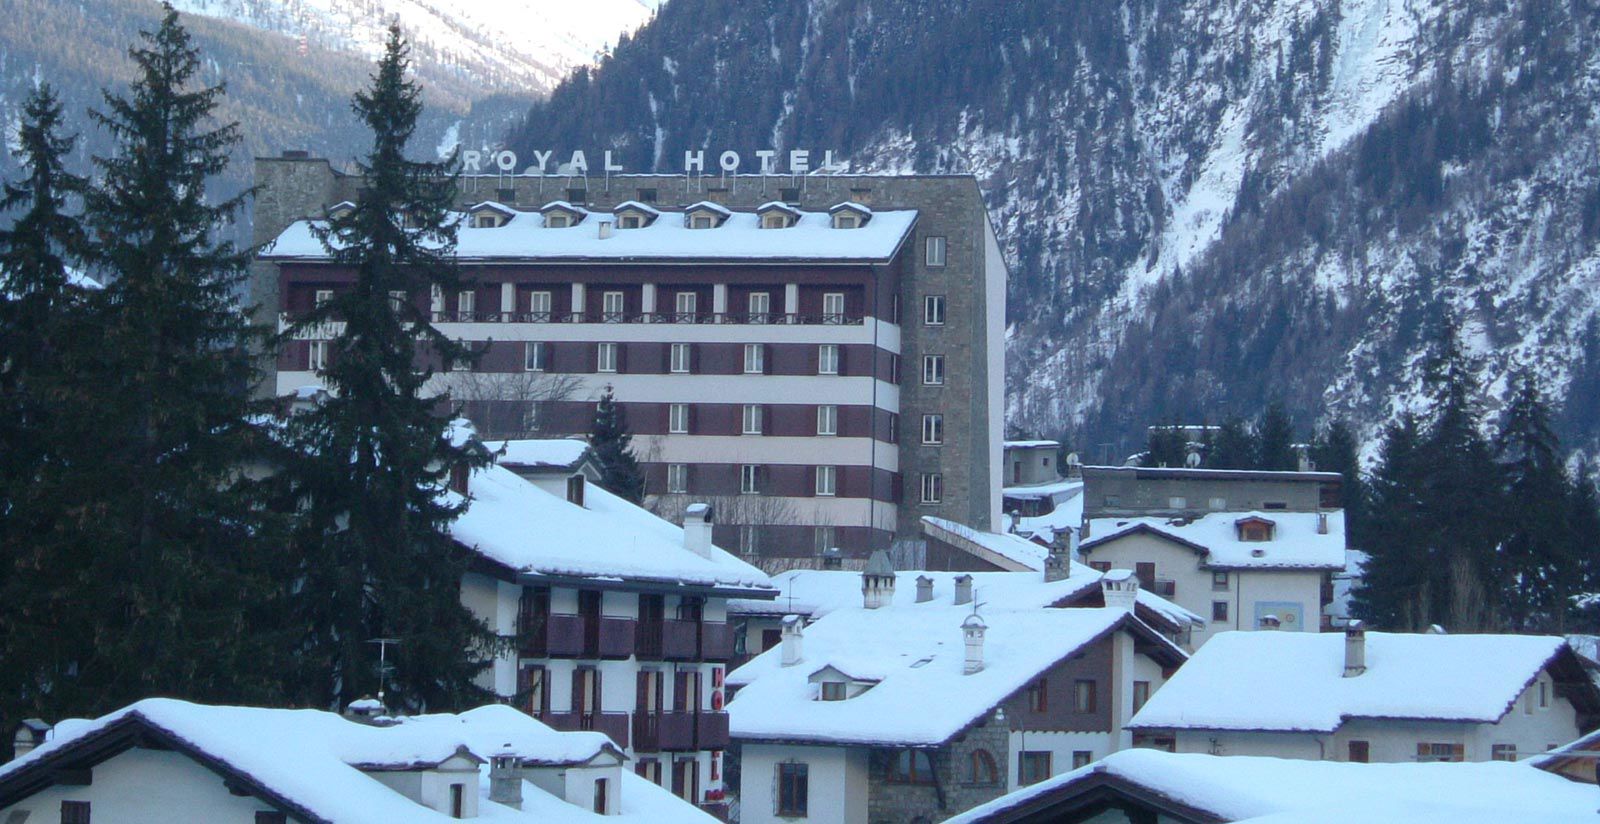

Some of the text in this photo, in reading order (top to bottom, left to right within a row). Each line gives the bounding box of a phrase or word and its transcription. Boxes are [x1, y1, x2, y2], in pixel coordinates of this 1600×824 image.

[462, 150, 840, 171] ROYAL HOTEL
[711, 668, 724, 781] HOL
